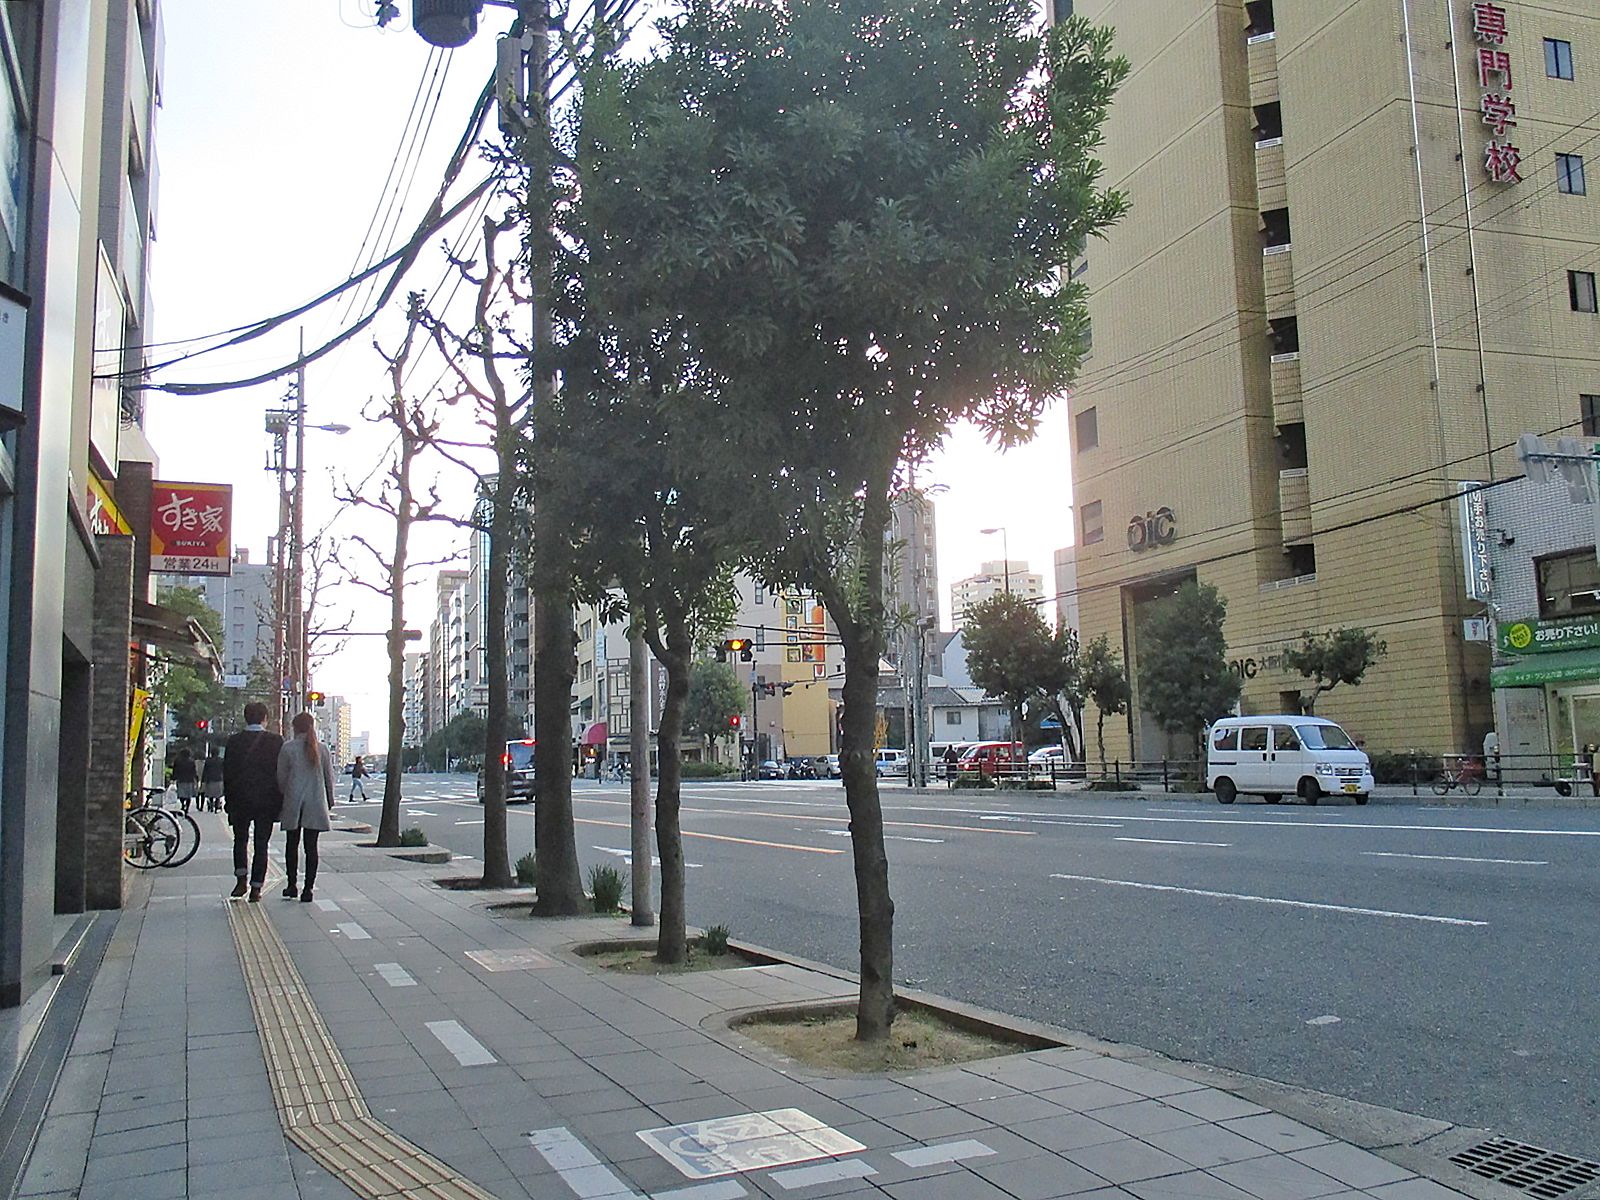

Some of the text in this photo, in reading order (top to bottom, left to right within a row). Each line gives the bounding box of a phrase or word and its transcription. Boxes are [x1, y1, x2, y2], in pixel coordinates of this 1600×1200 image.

[1472, 2, 1523, 184] 専門学校
[157, 492, 224, 538] すき家
[175, 540, 206, 548] SUKIYA
[163, 557, 220, 571] 営業24H
